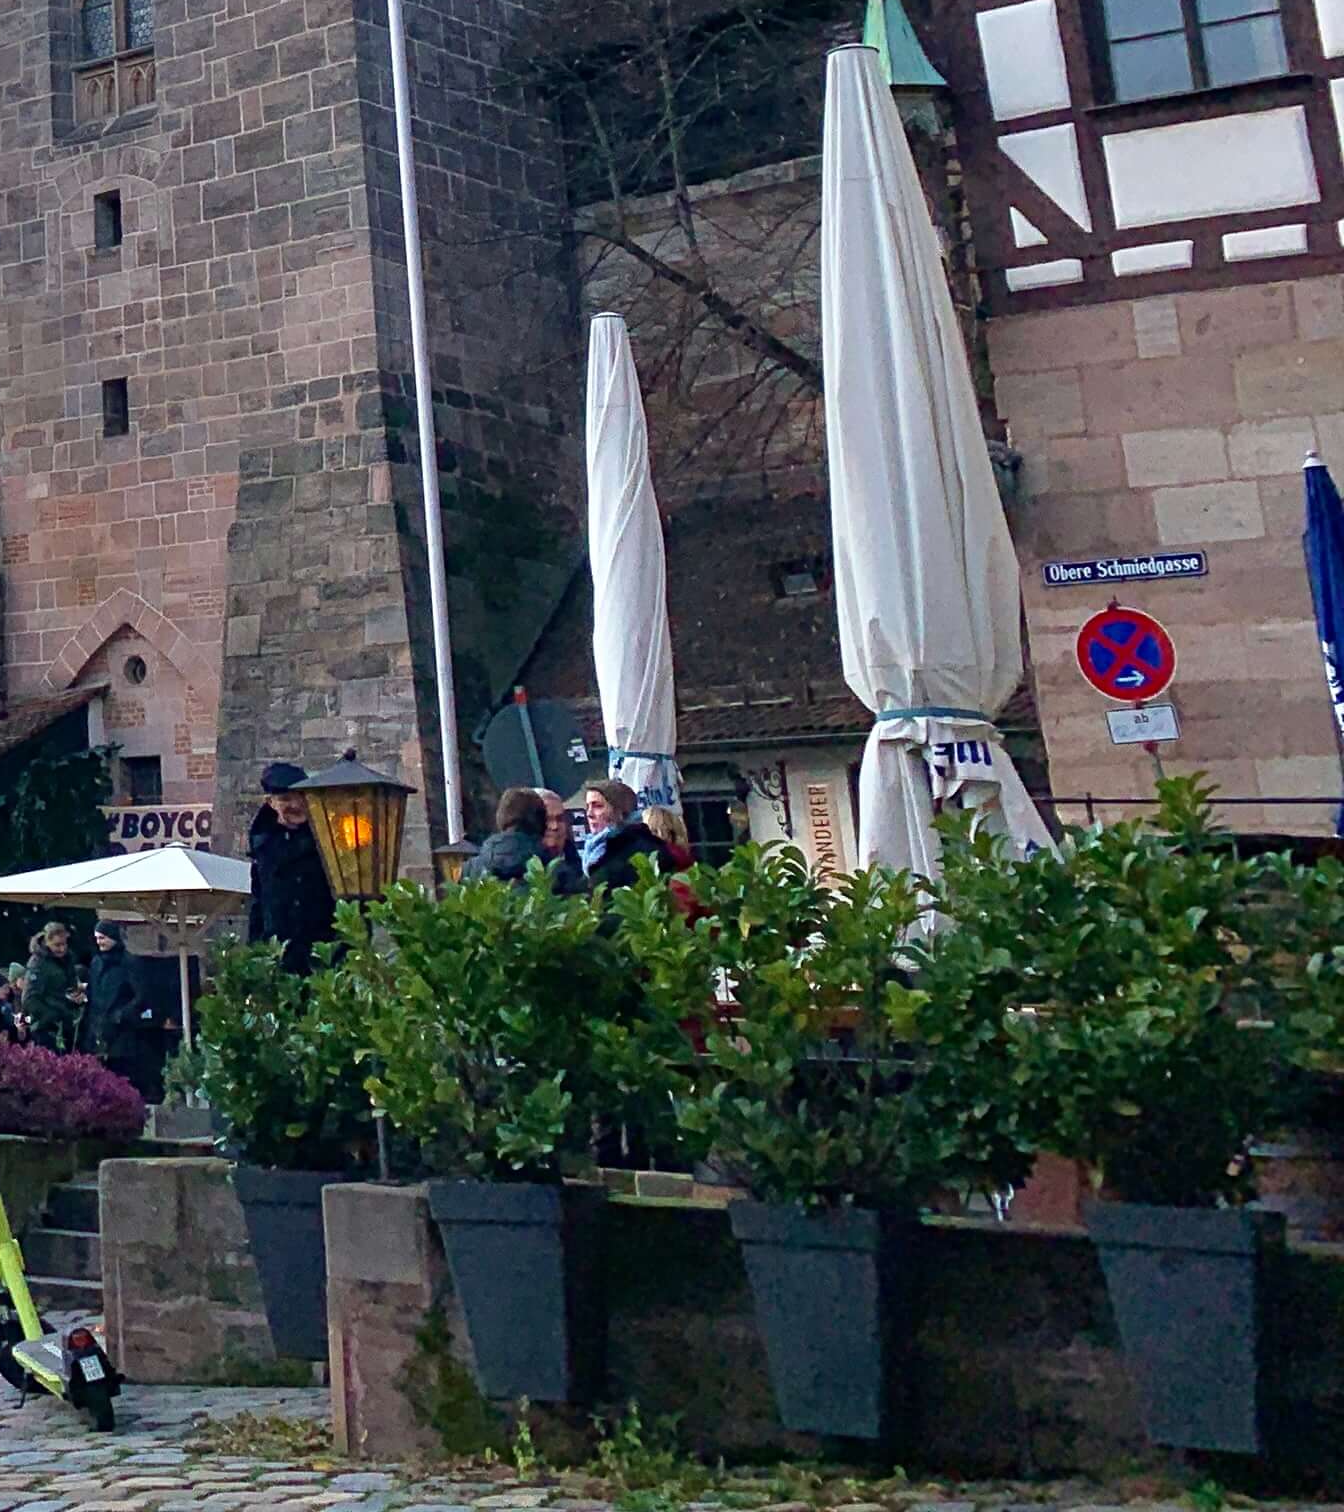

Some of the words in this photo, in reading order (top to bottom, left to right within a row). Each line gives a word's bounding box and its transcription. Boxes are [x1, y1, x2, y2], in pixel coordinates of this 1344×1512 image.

[1049, 565, 1093, 582] Obere
[1096, 557, 1199, 579] Schmiedgasse
[1134, 713, 1149, 724] ab
